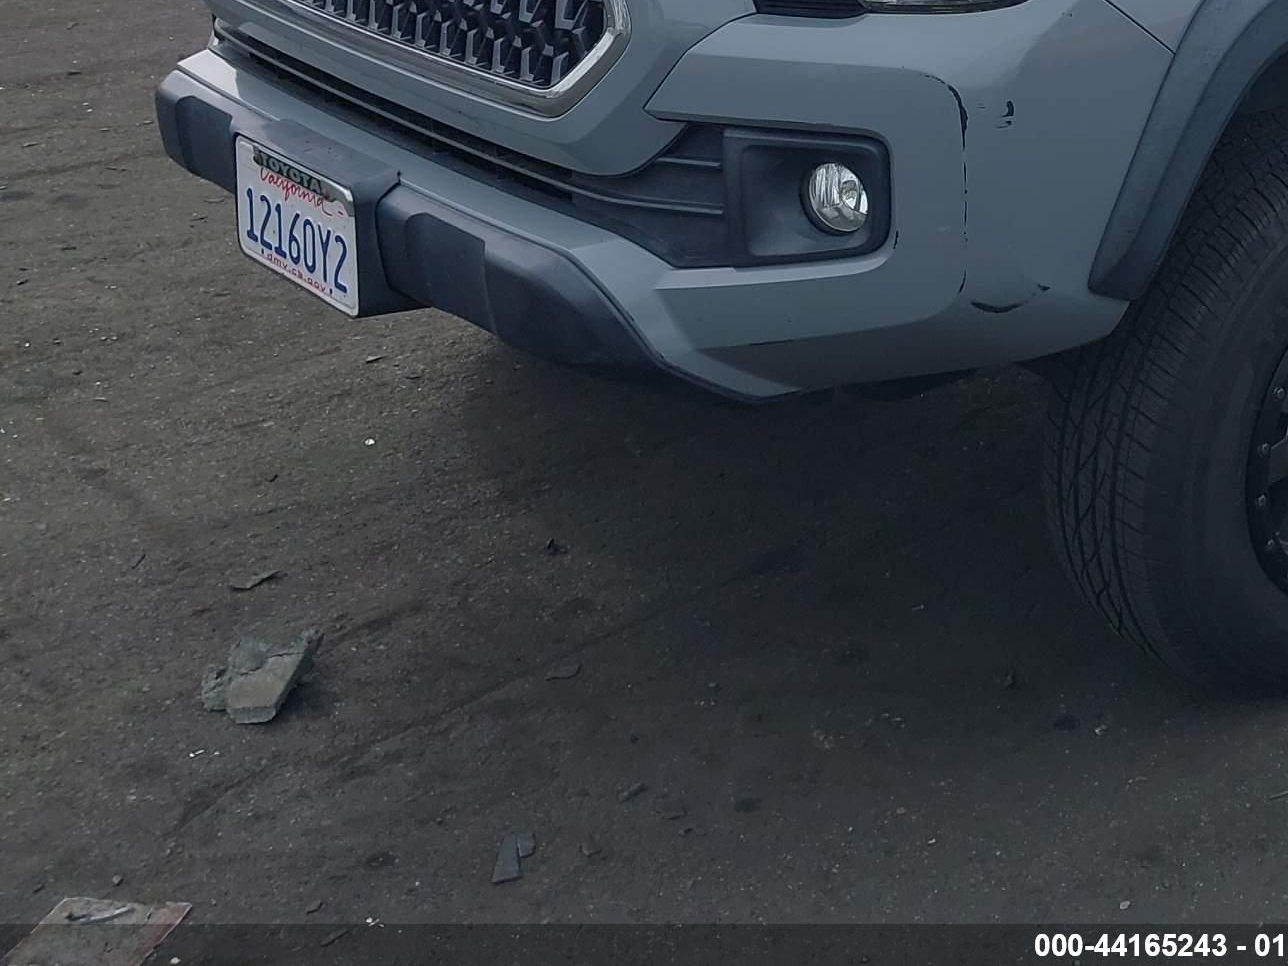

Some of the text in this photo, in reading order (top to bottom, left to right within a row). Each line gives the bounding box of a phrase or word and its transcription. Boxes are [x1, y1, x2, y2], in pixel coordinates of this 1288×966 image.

[260, 151, 322, 195] TOYOTA
[246, 187, 348, 294] 12160Y2
[267, 251, 327, 294] dmv.ca.gov
